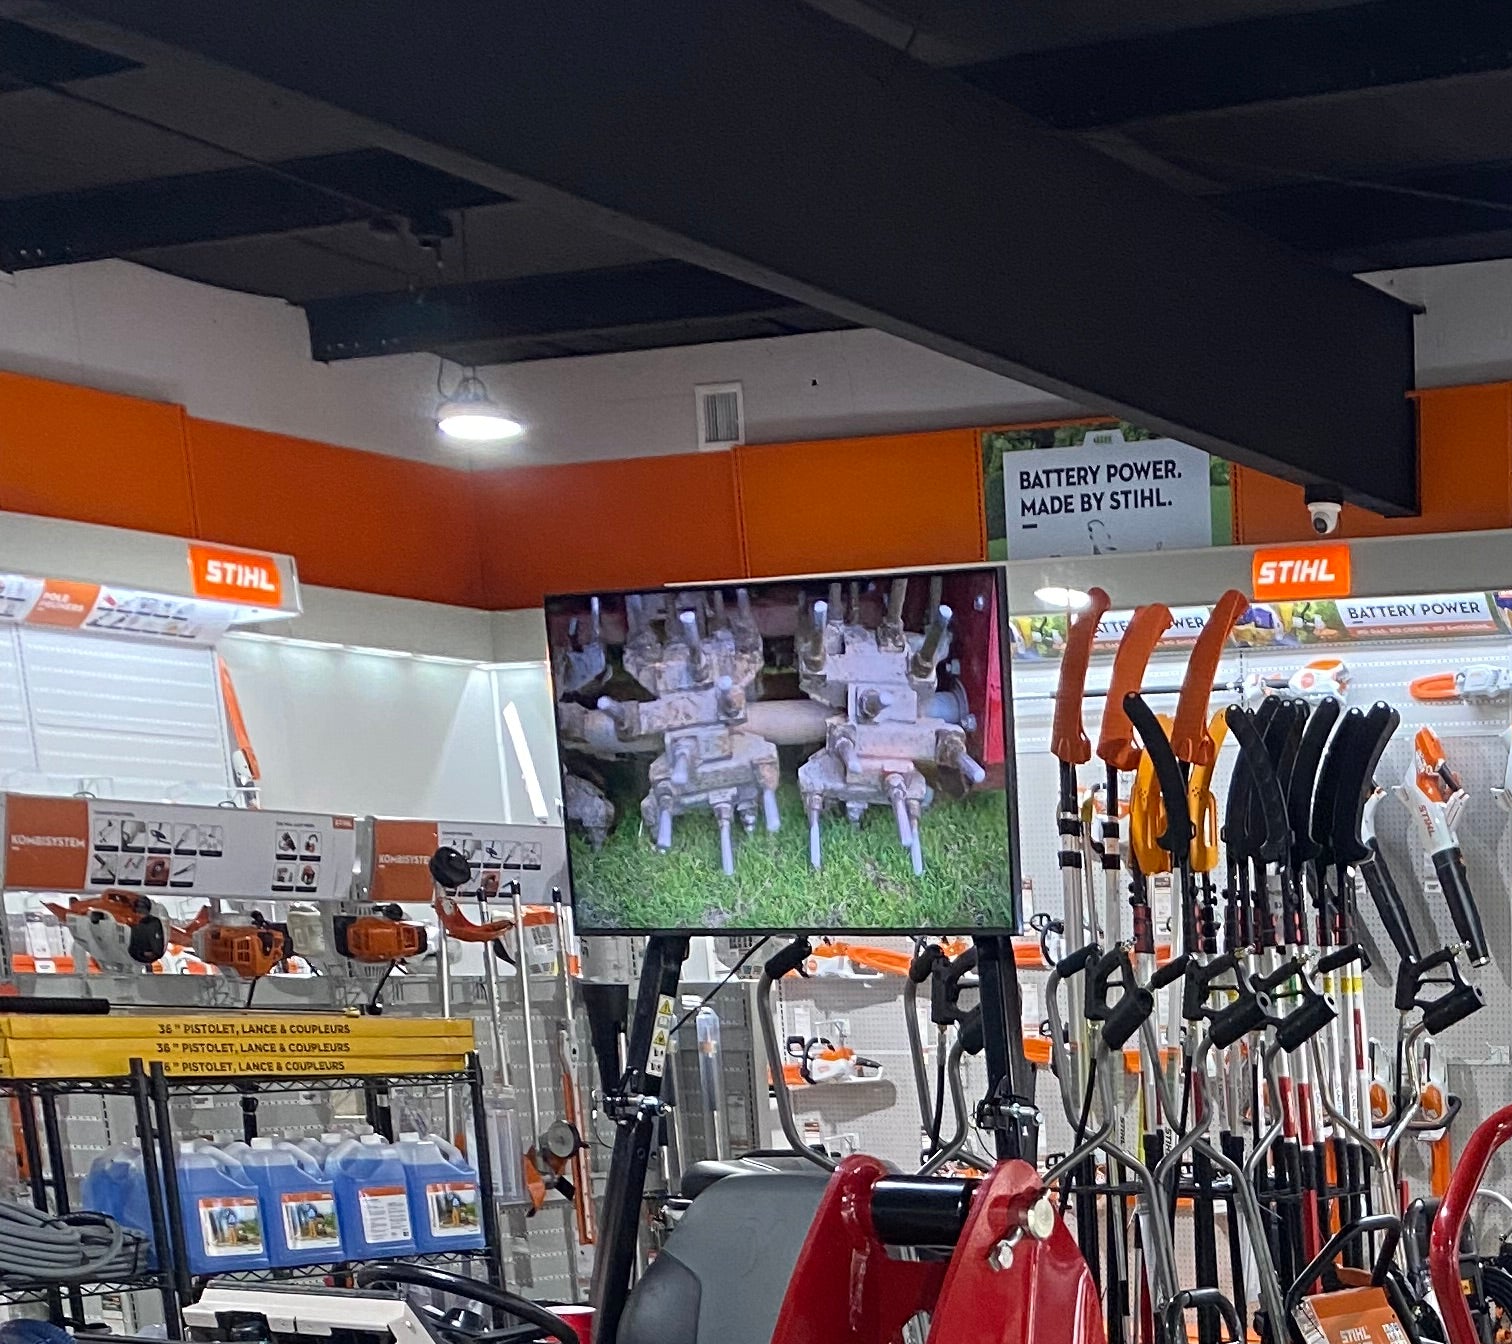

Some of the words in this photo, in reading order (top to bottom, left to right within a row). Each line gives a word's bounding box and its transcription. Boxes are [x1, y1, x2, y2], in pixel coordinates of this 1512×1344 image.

[1019, 465, 1100, 490] BATTERY
[1106, 459, 1182, 483] POWER.
[1021, 494, 1074, 516] MADE
[1081, 492, 1104, 512] BY
[1110, 488, 1173, 510] STIHL.
[206, 560, 276, 592] STIHL
[1257, 558, 1335, 585] STIHL
[1347, 604, 1415, 619] BATTERY
[1420, 601, 1481, 616] POWER
[1419, 804, 1435, 838] STIHL
[183, 1023, 239, 1036] PISTOLET,
[242, 1024, 277, 1034] LANCE
[280, 1024, 287, 1034] &
[289, 1024, 351, 1034] COUPLEURS
[182, 1043, 239, 1054] PISTOLET,
[240, 1042, 276, 1053] LANCE
[279, 1043, 286, 1052] &
[288, 1042, 350, 1052] COUPLEURS
[182, 1062, 237, 1073] PISTOLET,
[239, 1061, 273, 1072] LANCE
[276, 1062, 282, 1071] &
[285, 1061, 345, 1071] COUPLEURS
[1340, 1326, 1371, 1344] STIHL
